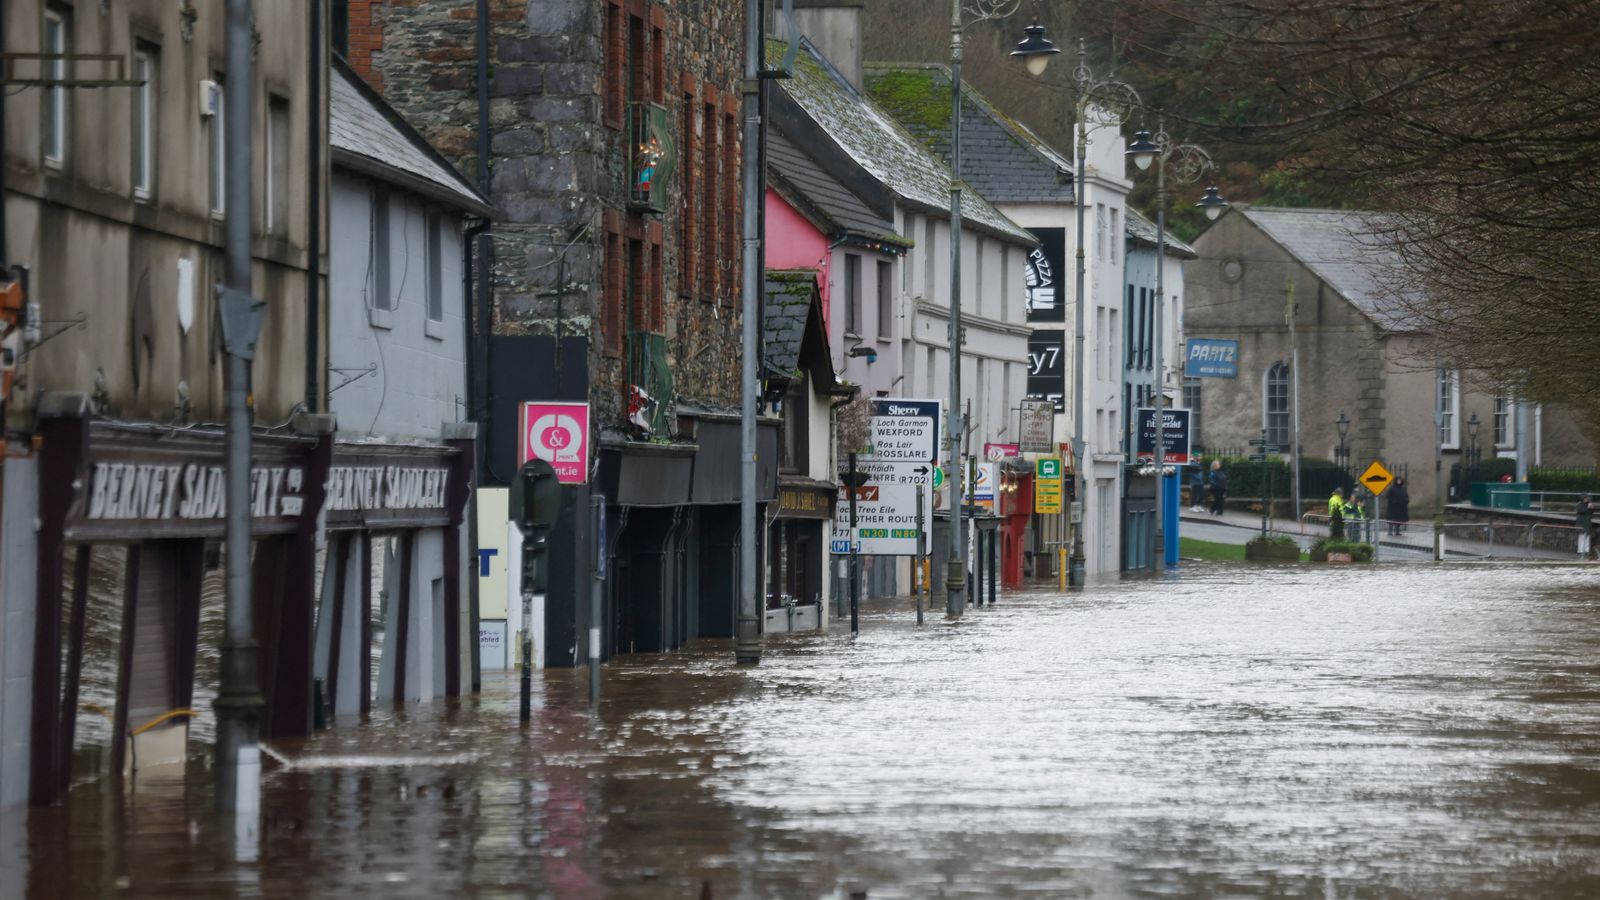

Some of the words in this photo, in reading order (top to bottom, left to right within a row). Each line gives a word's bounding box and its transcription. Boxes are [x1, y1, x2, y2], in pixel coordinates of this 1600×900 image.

[1030, 249, 1053, 287] PIZZA
[1190, 345, 1234, 362] PARTZ
[888, 405, 920, 416] Sherry
[1151, 413, 1175, 421] Serry
[877, 450, 926, 458] ROSSLARE
[88, 463, 182, 519] BERNEY
[326, 466, 384, 510] BERNEY
[384, 466, 449, 509] SADDLERY
[837, 505, 850, 513] ac
[880, 505, 896, 513] Eile
[833, 541, 860, 552] (M1)
[479, 549, 498, 577] T
